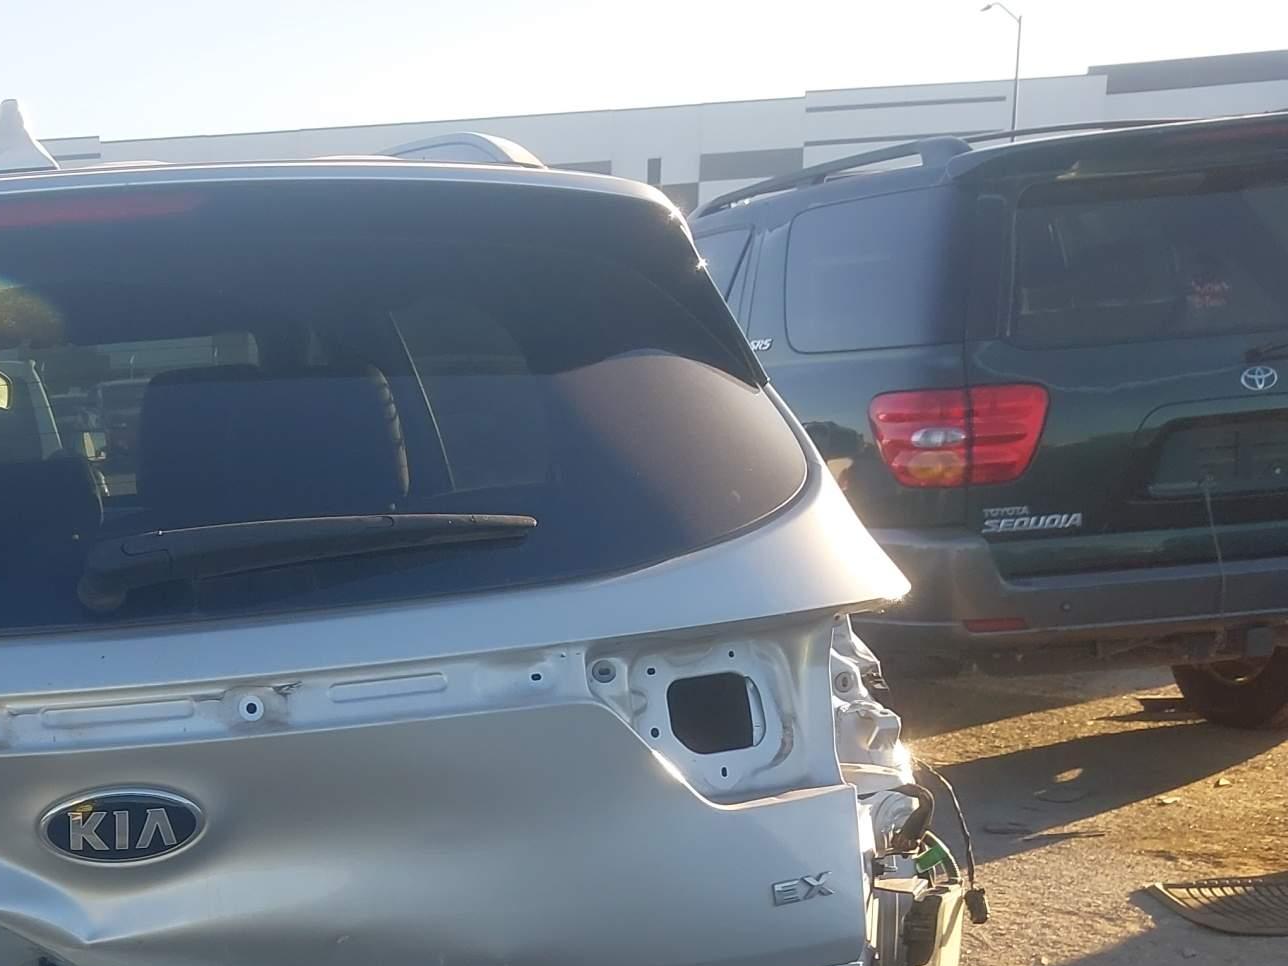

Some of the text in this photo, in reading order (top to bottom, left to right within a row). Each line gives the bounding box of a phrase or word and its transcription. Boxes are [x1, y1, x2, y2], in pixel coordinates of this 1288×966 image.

[981, 512, 1082, 533] SEQUOIA
[982, 505, 1029, 517] TOYOTA
[67, 808, 177, 851] KIA
[771, 871, 836, 907] EX
